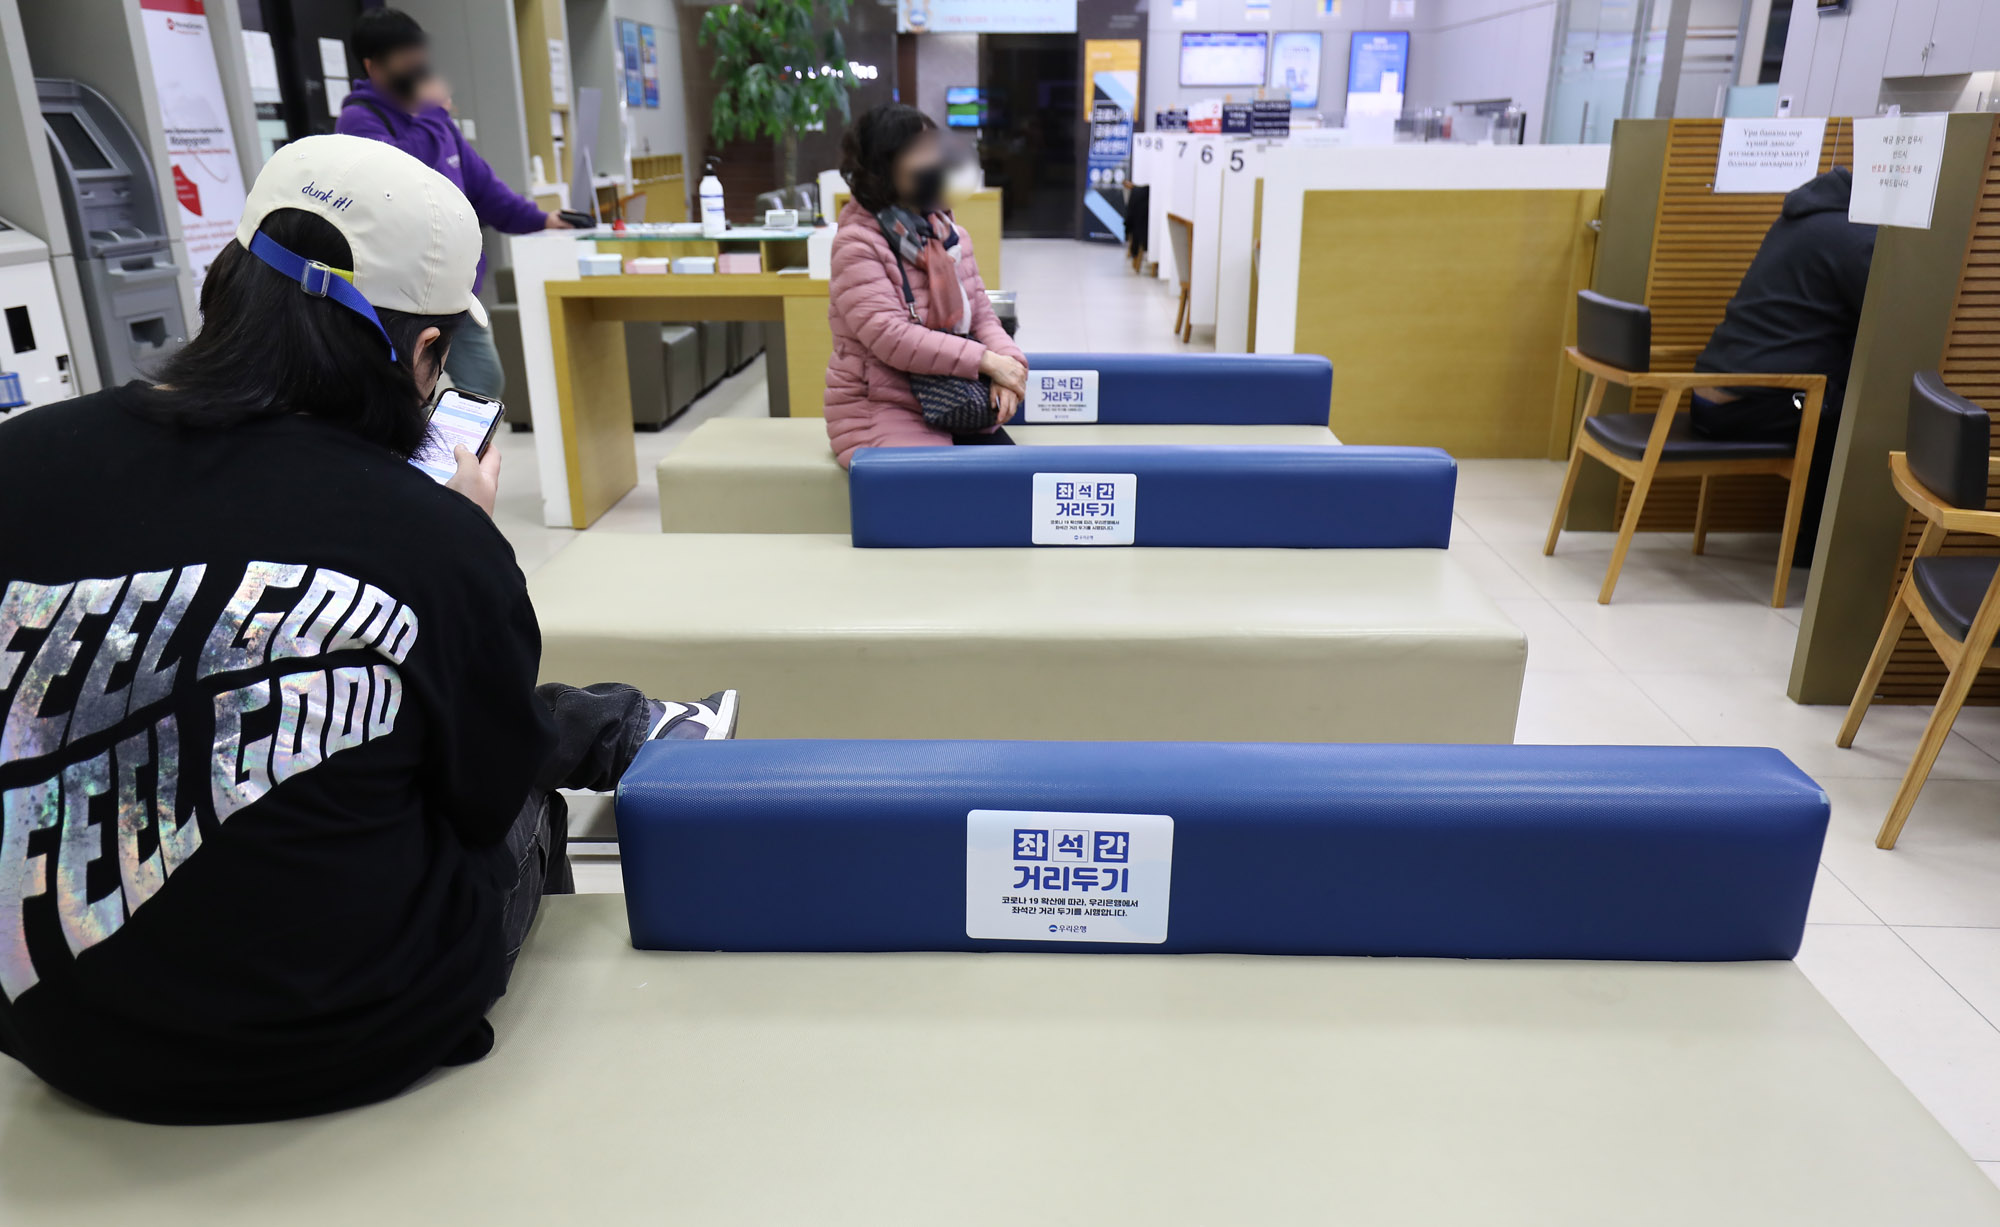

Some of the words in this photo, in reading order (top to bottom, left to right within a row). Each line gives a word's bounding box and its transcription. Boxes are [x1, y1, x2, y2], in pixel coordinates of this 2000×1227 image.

[1177, 141, 1188, 158] 7
[1201, 145, 1214, 164] 6
[1230, 149, 1244, 172] 5
[301, 181, 334, 203] dunk
[333, 197, 353, 212] it!
[1041, 391, 1083, 402] 거리두기
[1056, 502, 1114, 517] 거리두기
[0, 563, 207, 767] FEEL
[197, 560, 418, 682] GOOD
[0, 712, 203, 1005] FEEL
[210, 664, 402, 825] GOOD
[1013, 865, 1129, 893] 거리두기
[1001, 896, 1027, 905] 코로나
[1029, 897, 1039, 905] 19
[1040, 897, 1066, 906] 확산에
[1089, 898, 1139, 908] 우리은행에서
[1011, 907, 1037, 915] 좌석간
[1039, 907, 1055, 915] 거리
[1057, 907, 1082, 916] 두기를
[1084, 908, 1128, 917] 시행합니다.
[1058, 925, 1087, 934] 우리은행
